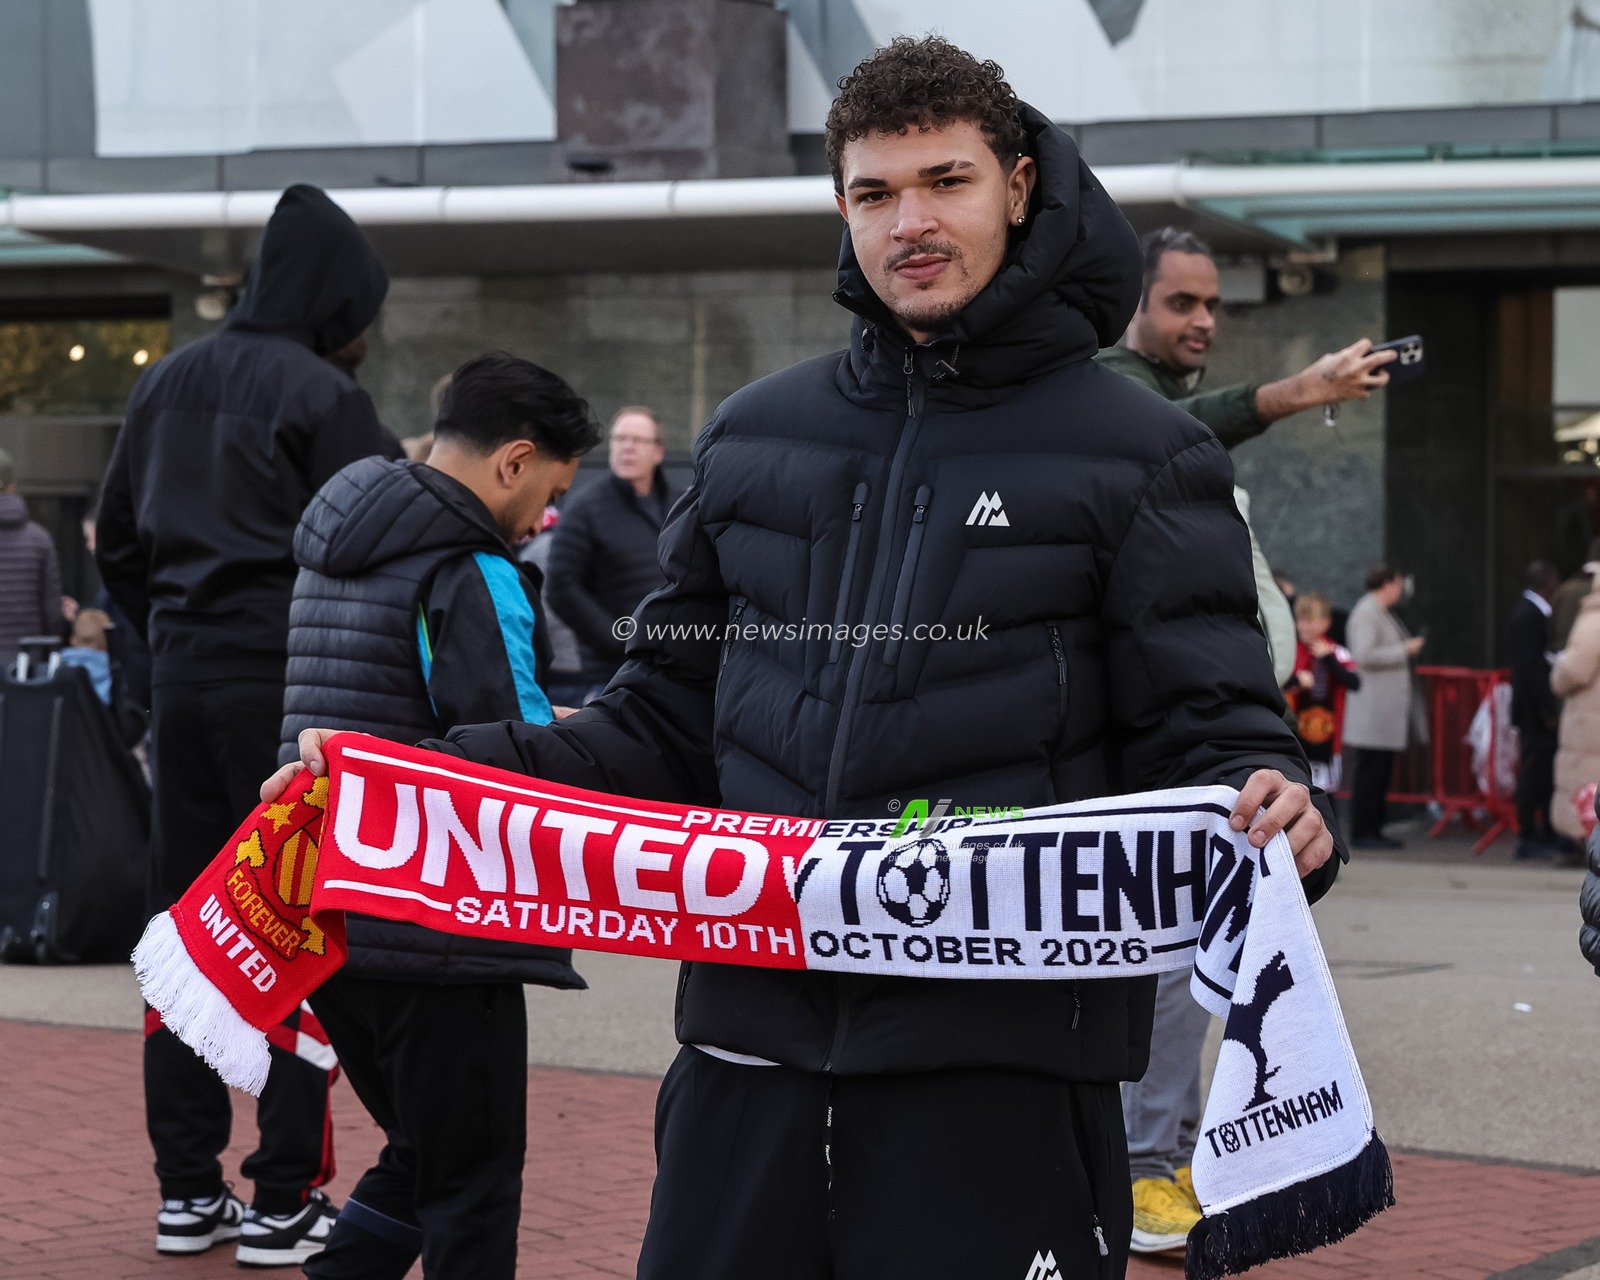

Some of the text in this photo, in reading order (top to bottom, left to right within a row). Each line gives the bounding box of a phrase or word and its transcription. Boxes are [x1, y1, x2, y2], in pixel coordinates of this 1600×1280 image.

[333, 771, 770, 917] UNITED
[682, 809, 973, 838] PREMIERSHIP
[199, 893, 278, 993] UNITED
[227, 868, 301, 957] FOREVER
[454, 896, 1149, 966] SATURDAY 10TH OCTOBER 2026
[1205, 1080, 1344, 1158] TOTTENHAM
